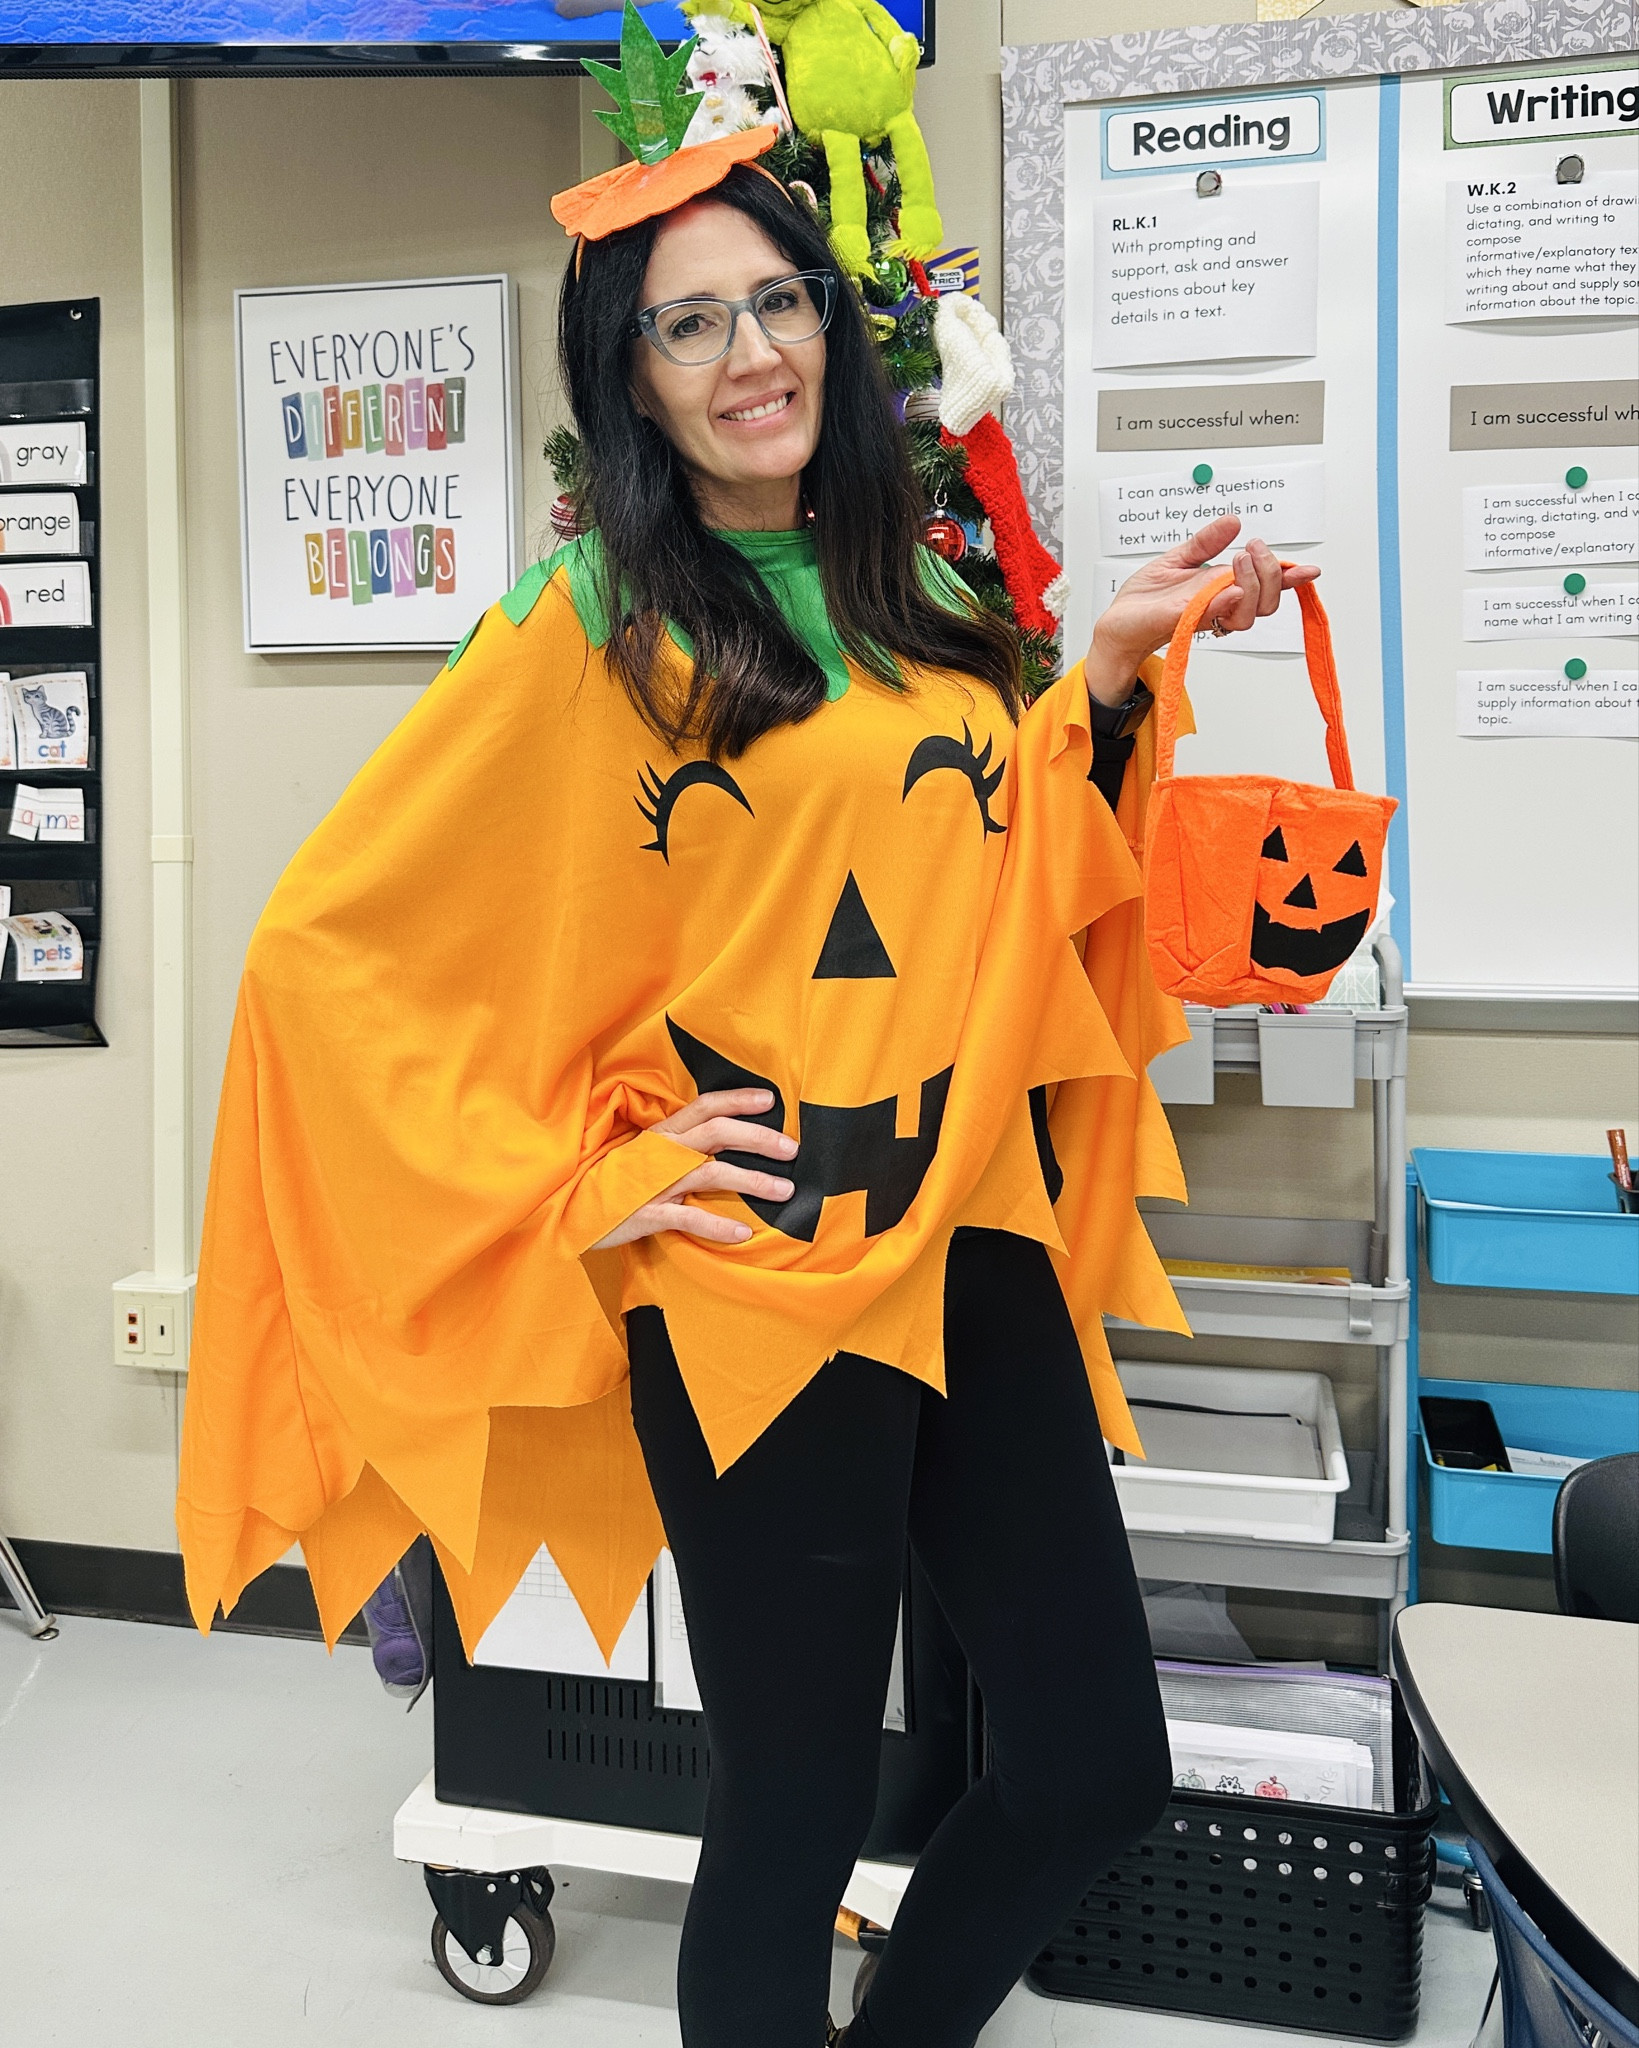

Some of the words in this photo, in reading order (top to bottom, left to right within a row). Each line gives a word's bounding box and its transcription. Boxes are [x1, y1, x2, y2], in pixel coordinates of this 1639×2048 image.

[1487, 83, 1639, 125] Writing
[1133, 114, 1291, 156] Reading
[1467, 181, 1517, 197] W.K.2
[1467, 203, 1489, 214] Use
[1493, 204, 1501, 212] a
[1505, 197, 1581, 211] combination
[1585, 195, 1599, 208] of
[1602, 194, 1639, 207] drawi
[1112, 216, 1157, 231] RL.K.1
[1467, 217, 1525, 231] dictating,
[1528, 215, 1552, 227] and
[1556, 213, 1599, 226] writing
[1603, 213, 1615, 223] to
[1112, 240, 1144, 254] With
[1148, 234, 1223, 255] prompting
[1227, 231, 1256, 246] and
[1467, 235, 1521, 248] compose
[1466, 245, 1616, 263] informative/explanatory
[1619, 244, 1639, 255] tex
[1112, 261, 1169, 280] support,
[1174, 259, 1198, 274] ask
[1202, 256, 1231, 271] and
[1236, 255, 1289, 269] answer
[1466, 266, 1502, 279] which
[1506, 264, 1532, 278] they
[1536, 263, 1571, 274] name
[1574, 261, 1606, 273] what
[1609, 260, 1637, 274] they
[930, 277, 960, 285] TRICT
[1111, 283, 1179, 304] questions
[1183, 281, 1227, 297] about
[1231, 278, 1256, 296] key
[1466, 283, 1508, 296] writing
[1512, 281, 1548, 292] about
[1552, 278, 1576, 290] and
[1580, 276, 1619, 292] supply
[1623, 278, 1639, 288] so
[1466, 298, 1535, 312] information
[1540, 295, 1576, 307] about
[1580, 294, 1600, 306] the
[1111, 308, 1158, 325] details
[1163, 307, 1175, 321] in
[1180, 309, 1189, 320] a
[1194, 304, 1226, 319] text.
[270, 324, 475, 384] EVERYONE'S
[287, 389, 462, 445] DIFFERENT
[1116, 416, 1122, 430] I
[1127, 417, 1153, 430] am
[1158, 410, 1243, 430] successful
[1249, 409, 1299, 426] when:
[1471, 411, 1477, 425] I
[1483, 413, 1510, 425] am
[1516, 404, 1608, 424] successful
[1614, 404, 1639, 421] wh
[16, 444, 68, 467] gray
[1118, 488, 1123, 499] I
[1127, 487, 1154, 499] can
[1159, 484, 1210, 497] answer
[1215, 477, 1285, 497] questions
[285, 474, 462, 523] EVERYONE
[1484, 498, 1488, 508] I
[1492, 499, 1511, 508] am
[1515, 492, 1577, 507] successful
[1581, 492, 1615, 504] when
[1618, 491, 1623, 501] I
[1119, 508, 1160, 523] about
[1165, 506, 1188, 523] key
[1193, 502, 1241, 518] details
[1246, 502, 1258, 514] in
[1263, 502, 1273, 513] a
[1484, 514, 1537, 526] drawing,
[1541, 510, 1600, 523] dictating,
[1604, 506, 1628, 519] and
[1119, 532, 1146, 545] text
[1150, 530, 1181, 544] with
[1484, 531, 1497, 541] to
[1500, 529, 1556, 542] compose
[1484, 542, 1635, 558] informative/explanatory
[309, 536, 454, 588] BELONGS
[26, 579, 65, 603] red
[1111, 580, 1116, 592] I
[1484, 600, 1488, 610] I
[1492, 601, 1511, 610] am
[1515, 596, 1578, 609] successful
[1581, 595, 1615, 607] when
[1619, 595, 1624, 605] I
[1484, 617, 1518, 627] name
[1522, 615, 1553, 625] what
[1556, 614, 1562, 624] I
[1565, 615, 1585, 624] am
[1588, 612, 1632, 625] writing
[1478, 681, 1482, 691] I
[1486, 682, 1505, 691] am
[1509, 680, 1572, 692] successful
[1575, 680, 1609, 691] when
[1613, 680, 1618, 691] I
[1621, 682, 1638, 691] ca
[1477, 697, 1516, 710] supply
[1520, 697, 1591, 708] information
[1594, 696, 1632, 708] about
[1478, 714, 1512, 726] topic.
[38, 740, 67, 758] cat
[22, 810, 34, 826] a
[46, 814, 80, 830] me
[34, 941, 72, 965] pets
